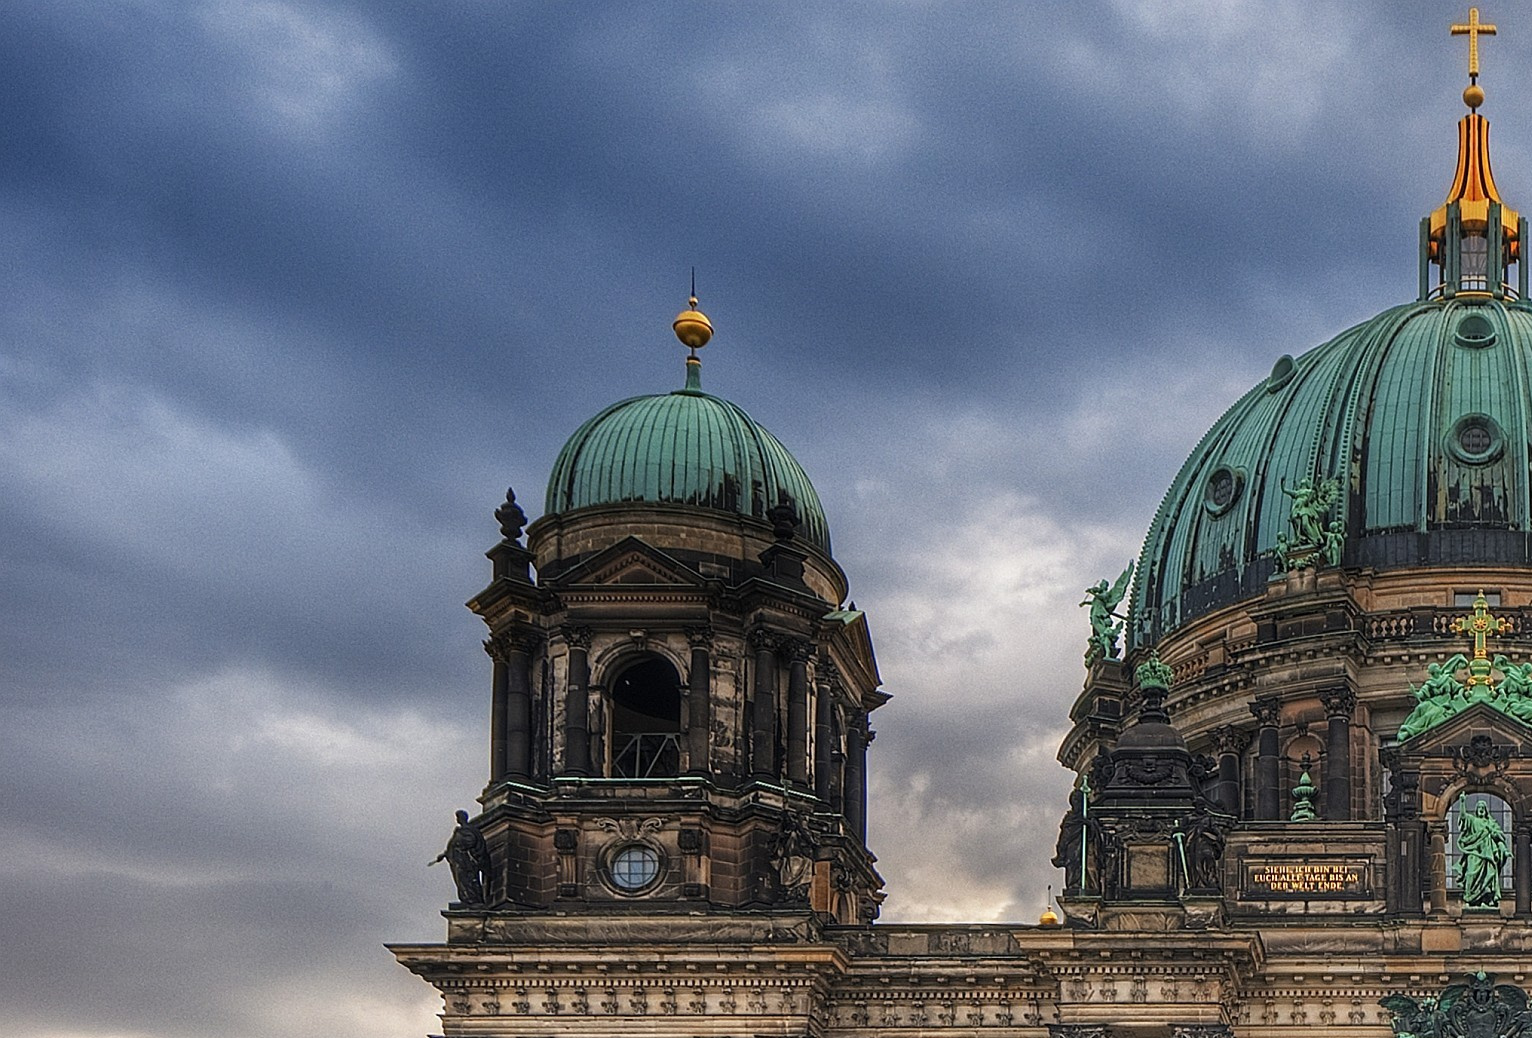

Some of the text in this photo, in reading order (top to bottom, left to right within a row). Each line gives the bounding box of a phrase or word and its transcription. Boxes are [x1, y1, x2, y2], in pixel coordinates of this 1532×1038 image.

[1295, 865, 1311, 874] ICH
[1314, 865, 1330, 873] BIN
[1333, 865, 1348, 873] BEI
[1254, 874, 1359, 882] EUCH ALLE TAGE BIS AN
[1271, 882, 1289, 890] DER
[1291, 882, 1315, 890] WELT
